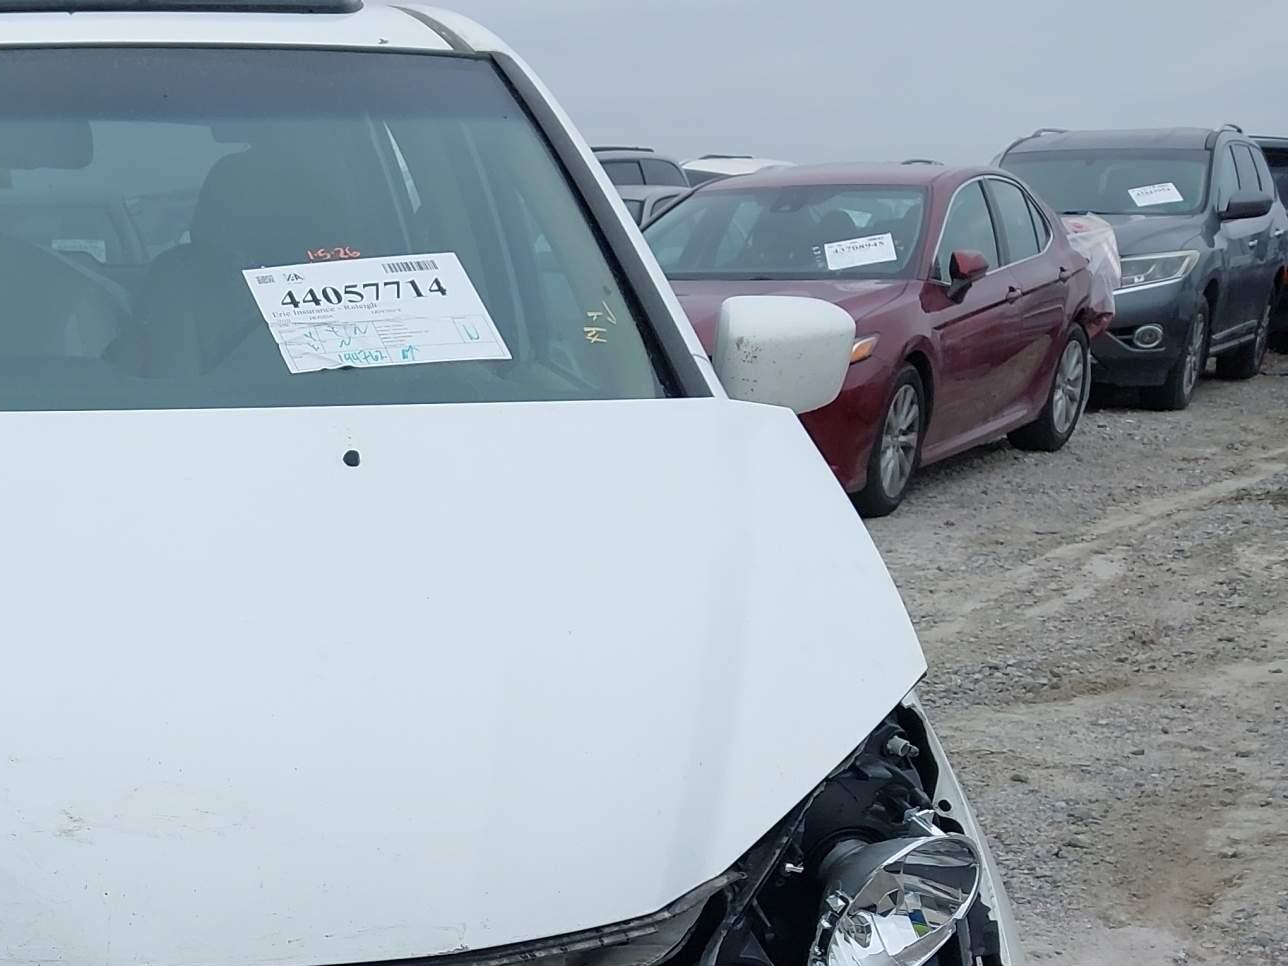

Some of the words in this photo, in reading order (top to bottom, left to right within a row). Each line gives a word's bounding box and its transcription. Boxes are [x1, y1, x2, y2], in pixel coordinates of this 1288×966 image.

[281, 278, 447, 308] 44057714
[293, 305, 336, 317] Insurance
[343, 302, 378, 312] Raleigh
